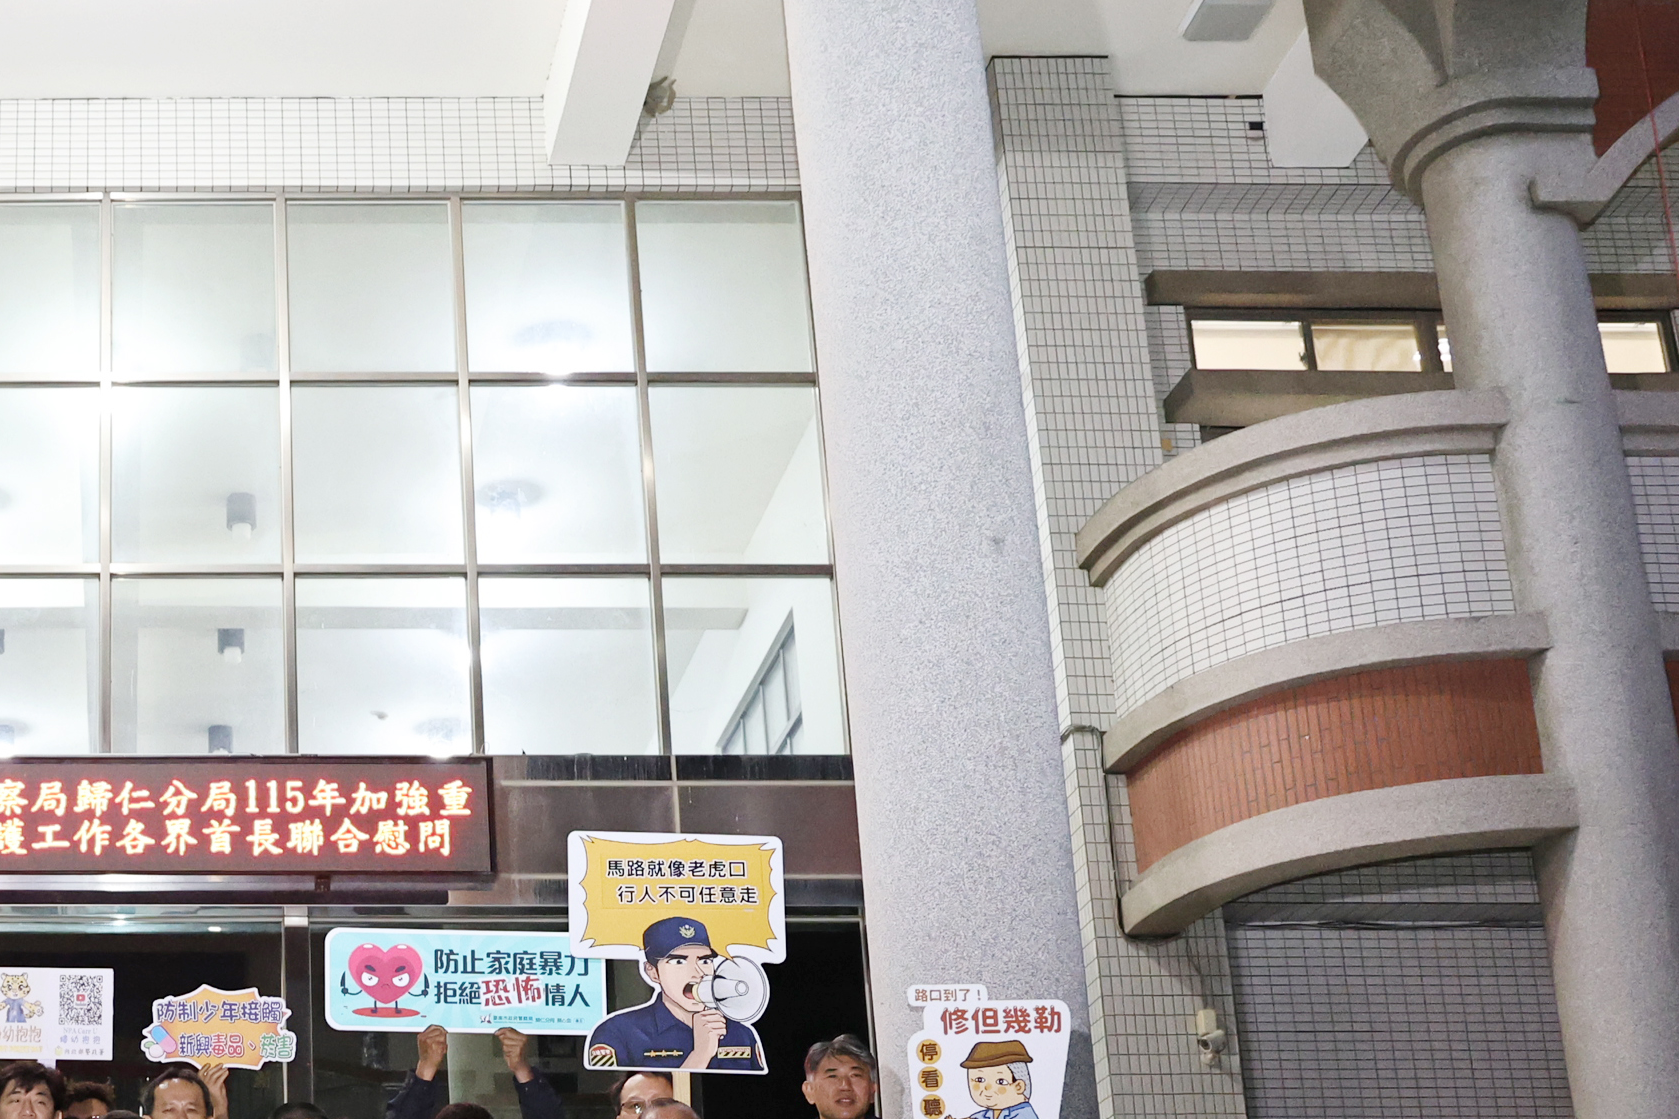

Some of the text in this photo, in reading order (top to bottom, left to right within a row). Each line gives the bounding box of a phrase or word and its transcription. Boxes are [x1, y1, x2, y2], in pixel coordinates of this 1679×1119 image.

[607, 860, 746, 878] 馬路就像老虎口
[617, 886, 758, 905] 行人不可任意走
[434, 949, 590, 976] 防止家庭暴力
[434, 976, 591, 1008] 拒絕恐怖情人
[157, 1000, 283, 1023] 防制少年接觸
[941, 1006, 1062, 1035] 修但幾勒
[179, 1033, 293, 1058] 新興毒品、菸害
